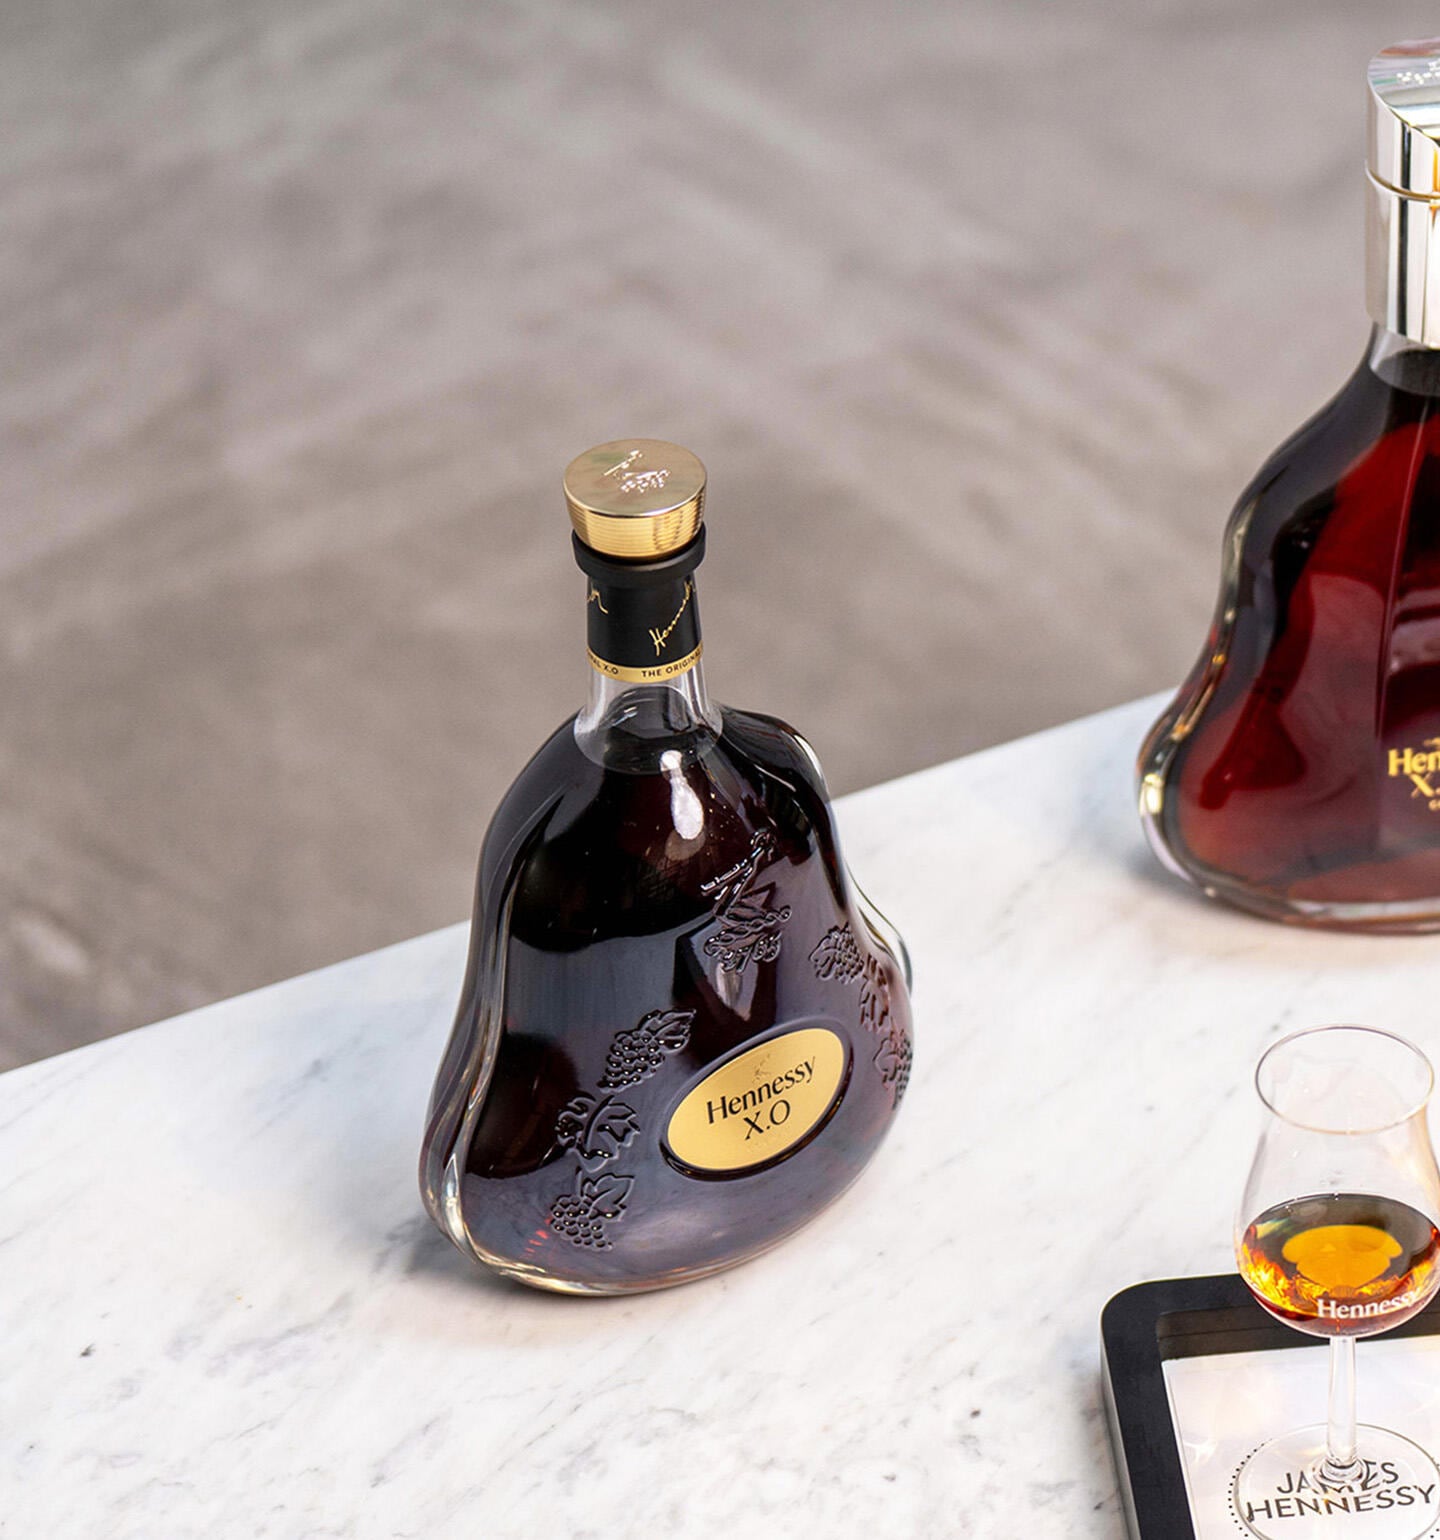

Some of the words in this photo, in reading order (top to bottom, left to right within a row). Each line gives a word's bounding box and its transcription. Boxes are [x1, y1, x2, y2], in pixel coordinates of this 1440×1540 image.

[641, 669, 663, 678] THE
[706, 1055, 816, 1125] Hennessy
[743, 1099, 791, 1141] X.O
[1317, 1287, 1421, 1319] Hennessy
[1246, 1484, 1436, 1522] HENNESSY
